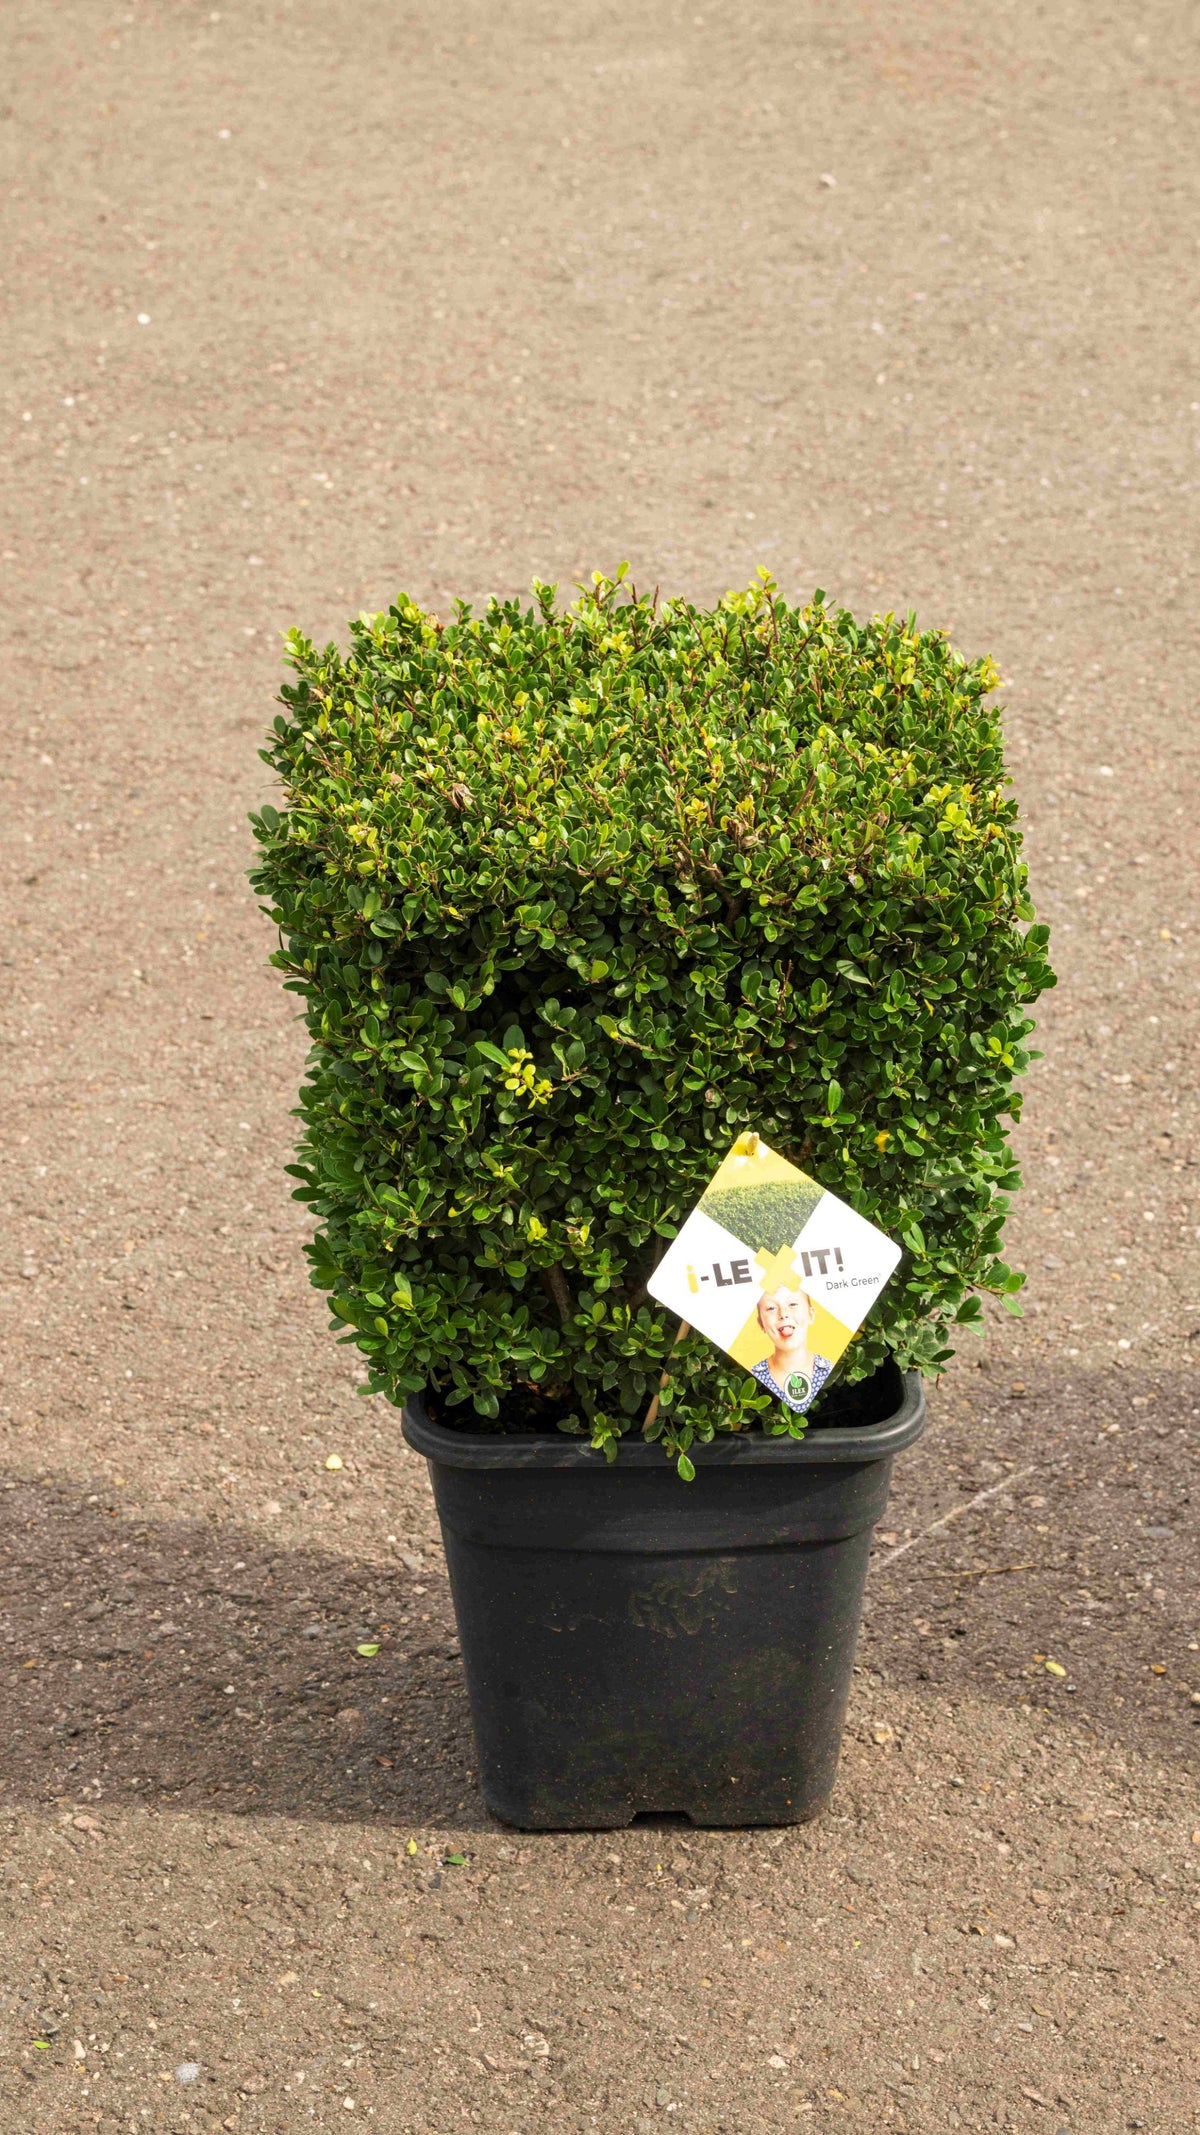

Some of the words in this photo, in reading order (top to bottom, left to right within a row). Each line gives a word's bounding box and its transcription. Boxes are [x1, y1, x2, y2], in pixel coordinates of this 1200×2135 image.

[801, 1247, 844, 1277] IT!
[825, 1279, 849, 1291] Dark
[851, 1276, 880, 1287] Green
